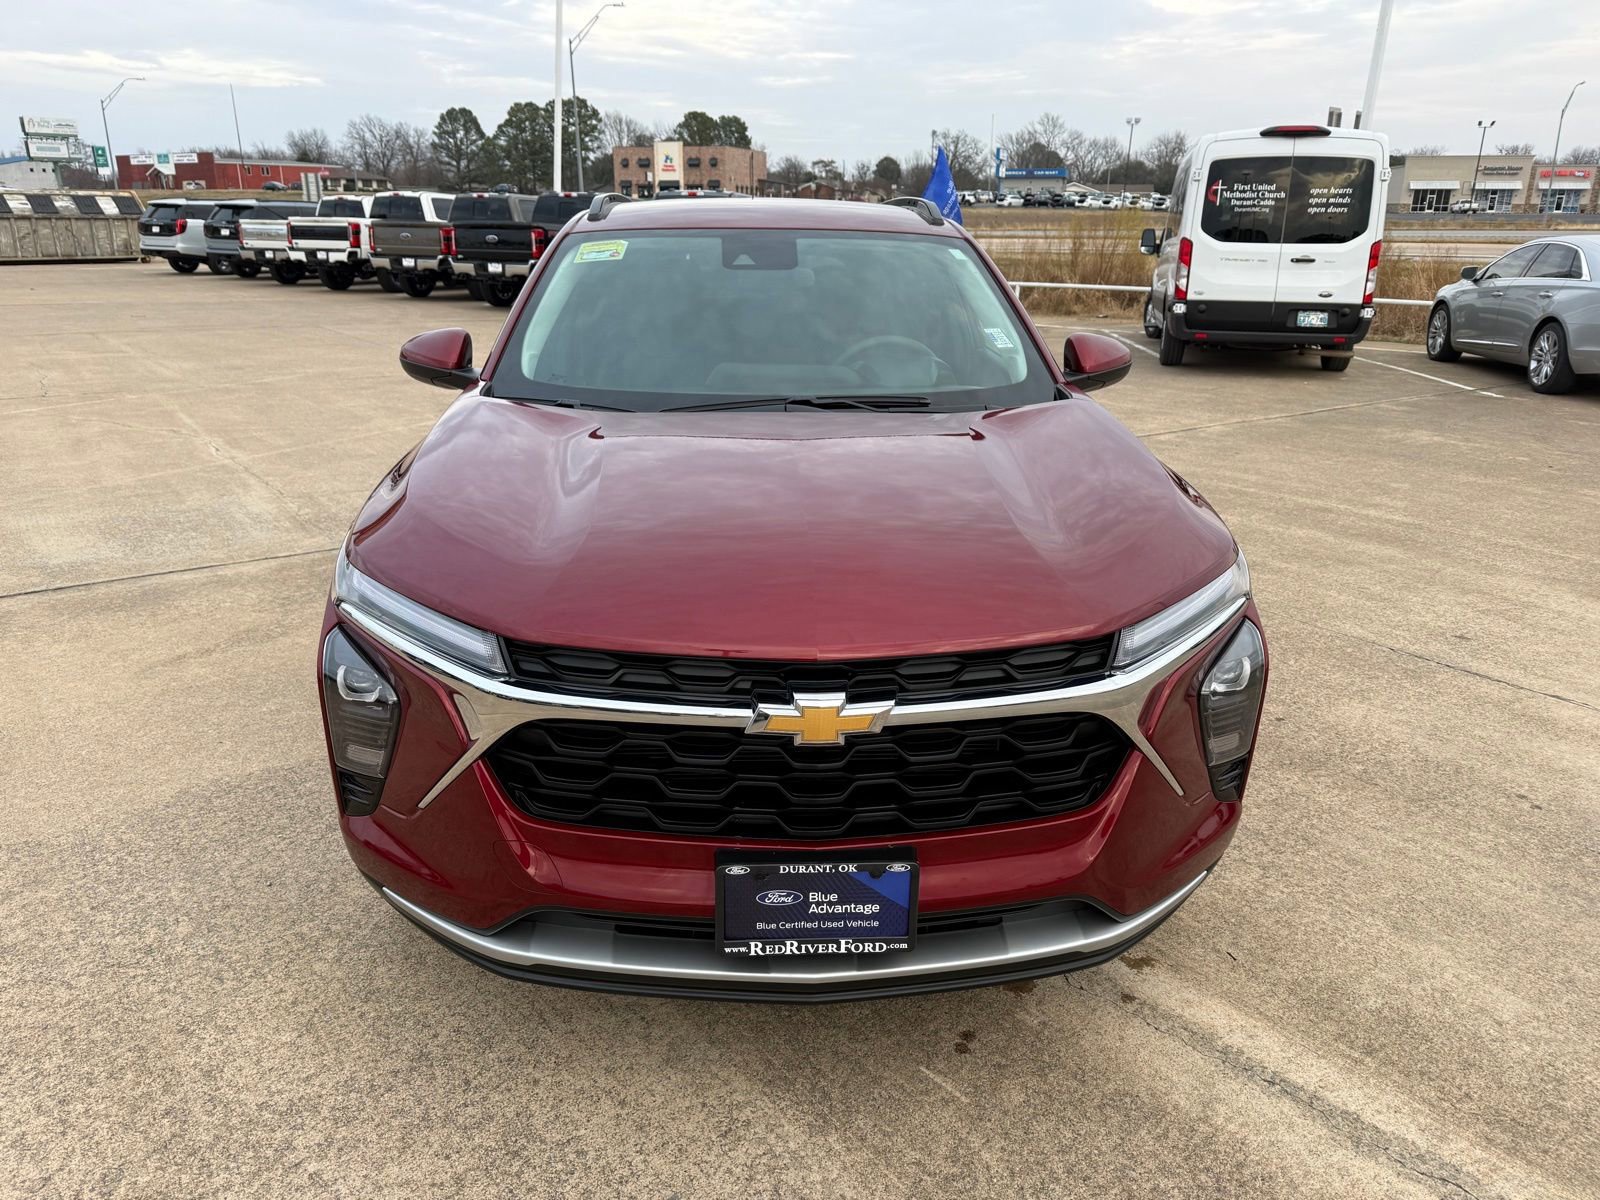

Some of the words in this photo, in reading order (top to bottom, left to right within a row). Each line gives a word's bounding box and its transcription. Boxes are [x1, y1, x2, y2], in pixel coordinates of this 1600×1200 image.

[1233, 183, 1250, 191] First
[1252, 183, 1276, 191] United
[1310, 188, 1328, 196] open
[1329, 186, 1353, 194] hearts
[1223, 190, 1257, 198] Methodist
[1309, 197, 1327, 205] open
[1307, 207, 1325, 215] open
[1327, 205, 1348, 213] doors
[779, 865, 835, 874] DURANT,
[838, 864, 858, 873] OK
[763, 891, 796, 904] Ford
[808, 892, 838, 902] Blue
[808, 903, 880, 914] Advantage
[756, 922, 777, 930] Blue
[779, 921, 818, 929] Certified
[820, 920, 844, 928] Used
[846, 919, 880, 927] Vehicle
